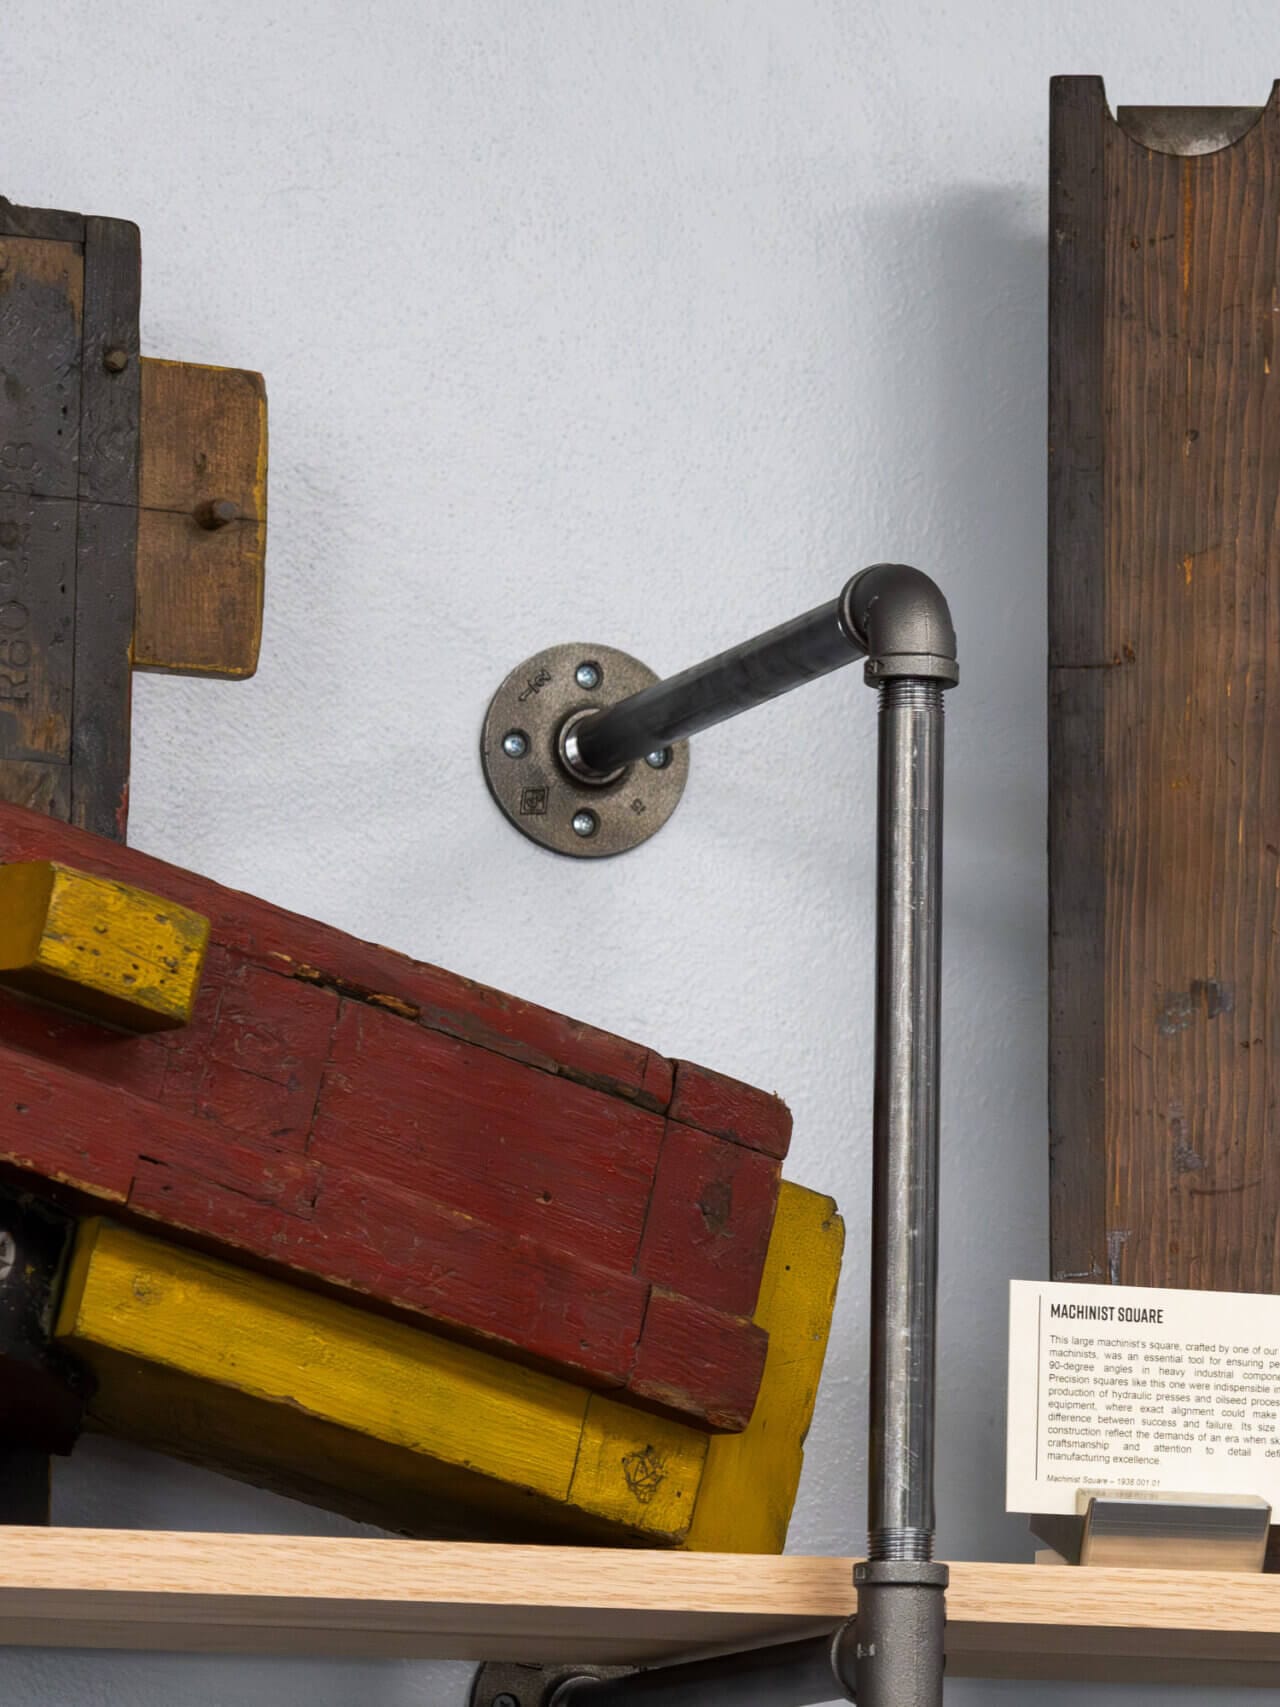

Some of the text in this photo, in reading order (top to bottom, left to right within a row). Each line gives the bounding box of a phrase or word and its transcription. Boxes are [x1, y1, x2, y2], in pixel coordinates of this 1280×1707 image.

[1051, 1304, 1164, 1324] MACHINIST SQUARE
[1050, 1335, 1069, 1344] This
[1072, 1336, 1094, 1348] large
[1186, 1343, 1216, 1352] crafted
[1219, 1344, 1230, 1354] by
[1232, 1346, 1250, 1354] one
[1252, 1346, 1261, 1355] of
[1264, 1348, 1279, 1356] our
[1049, 1361, 1095, 1373] 90-degree
[1104, 1365, 1133, 1375] angles
[1159, 1367, 1185, 1378] heavy
[1194, 1368, 1234, 1379] industrial
[1144, 1355, 1184, 1363] essential
[1188, 1356, 1204, 1364] tool
[1210, 1356, 1222, 1365] for
[1226, 1359, 1264, 1369] ensuring
[1049, 1374, 1090, 1384] Precision
[1093, 1378, 1129, 1386] squares
[1132, 1379, 1147, 1387] like
[1150, 1380, 1166, 1388] this
[1214, 1384, 1270, 1393] indispensible
[1048, 1388, 1095, 1397] production
[1099, 1390, 1108, 1398] of
[1112, 1391, 1152, 1400] hydraulic
[1156, 1394, 1191, 1402] presses
[1216, 1396, 1247, 1405] oilseed
[1105, 1403, 1133, 1412] where
[1140, 1406, 1164, 1414] exact
[1171, 1407, 1214, 1417] alignment
[1221, 1410, 1245, 1418] could
[1253, 1411, 1277, 1419] make
[1048, 1412, 1092, 1423] difference
[1098, 1416, 1135, 1425] between
[1141, 1419, 1177, 1427] success
[1241, 1422, 1252, 1431] Its
[1258, 1424, 1276, 1432] size
[1048, 1427, 1101, 1436] construction
[1105, 1428, 1133, 1438] reflect
[1136, 1430, 1150, 1439] the
[1153, 1432, 1195, 1441] demands
[1198, 1433, 1207, 1442] of
[1243, 1436, 1267, 1444] when
[1048, 1439, 1110, 1451] craftsmanship
[1123, 1443, 1140, 1451] and
[1154, 1444, 1192, 1454] attention
[1205, 1446, 1215, 1455] to
[1228, 1448, 1252, 1456] detail
[1047, 1452, 1111, 1464] manufacturing
[1046, 1474, 1080, 1483] Machinist
[1083, 1476, 1108, 1485] Square
